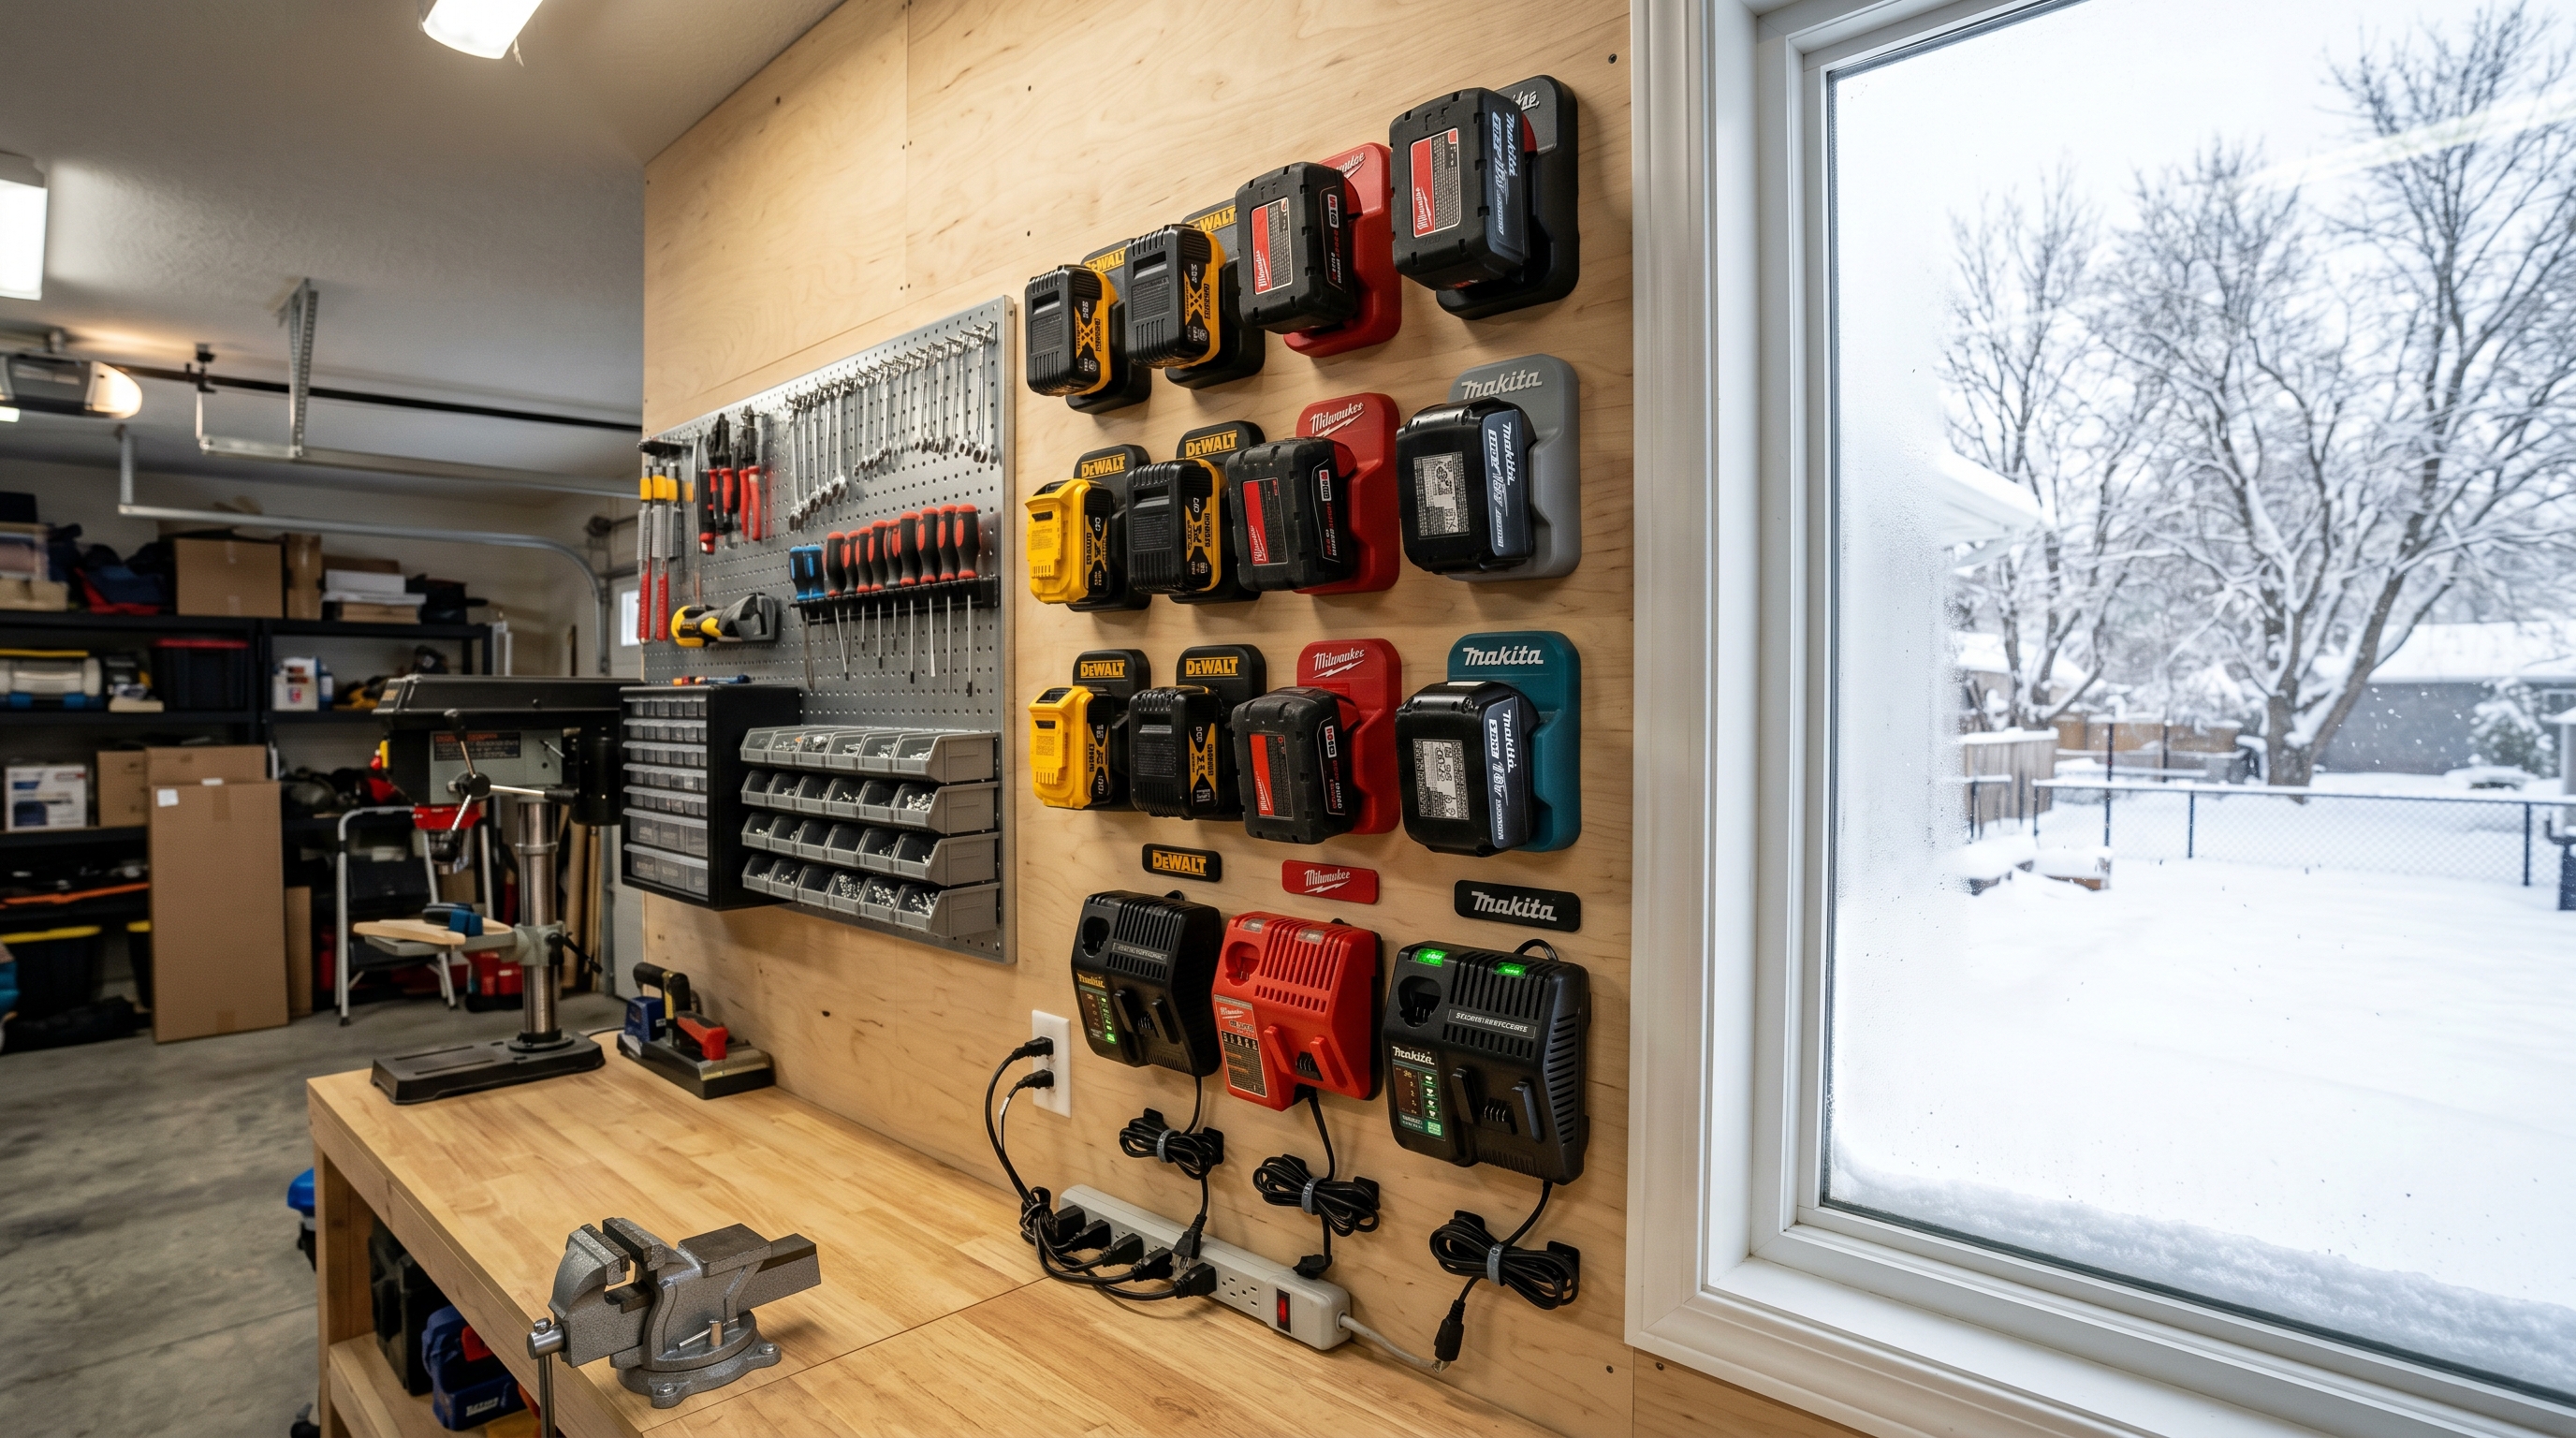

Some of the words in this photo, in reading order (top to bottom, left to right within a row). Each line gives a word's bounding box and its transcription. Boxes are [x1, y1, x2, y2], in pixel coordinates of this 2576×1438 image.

[1461, 369, 1543, 400] Makita
[1312, 648, 1365, 671] Milwaukee
[1463, 646, 1544, 667] Makita
[1471, 891, 1557, 921] Makita
